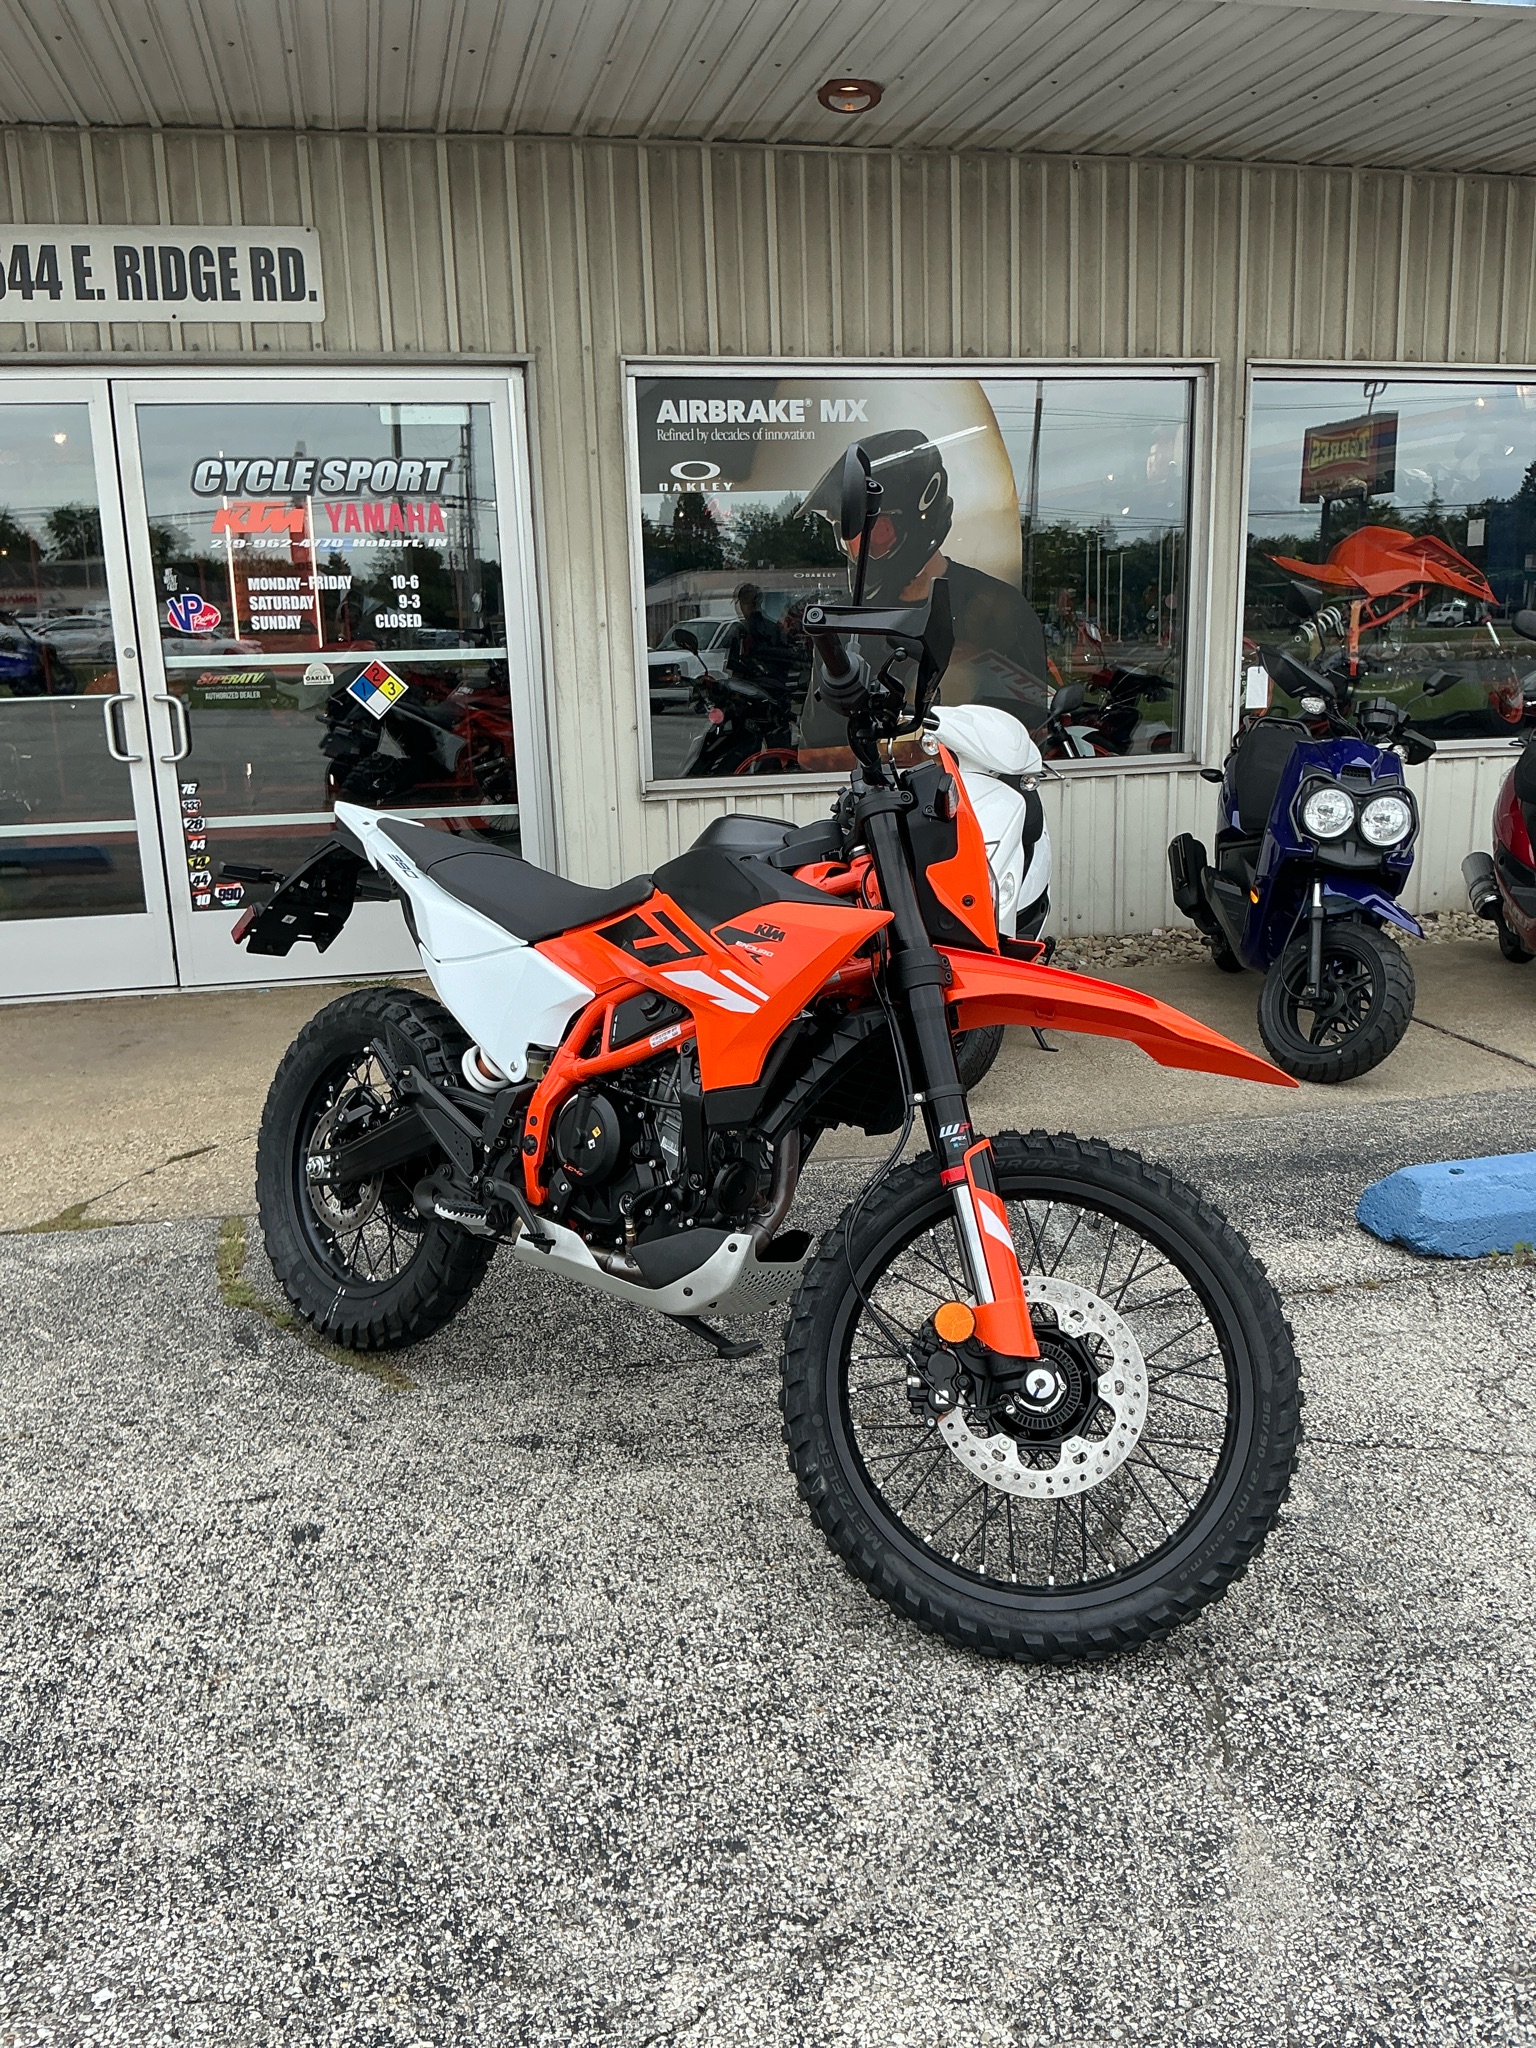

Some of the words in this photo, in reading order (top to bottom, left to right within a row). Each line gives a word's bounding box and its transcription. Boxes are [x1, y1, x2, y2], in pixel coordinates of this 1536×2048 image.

[0, 244, 62, 300] 44
[71, 245, 106, 301] E.
[113, 245, 241, 302] RIDGE
[249, 246, 318, 302] RD.
[820, 399, 869, 423] MX
[656, 428, 694, 441] Refined
[696, 428, 708, 444] by
[710, 428, 750, 441] decades
[752, 428, 764, 441] of
[764, 428, 816, 440] innovation
[192, 457, 316, 495] CYCLE
[318, 457, 450, 495] SPORT
[659, 482, 733, 492] OAKLEY
[211, 501, 305, 533] KTM
[324, 502, 446, 533] YAMAHA
[352, 538, 424, 549] Hobart,
[427, 538, 449, 548] IN
[391, 574, 420, 590] 10-6
[249, 595, 315, 611] SATURDAY
[398, 594, 421, 609] 9-3
[167, 593, 203, 632] VP
[251, 615, 302, 630] SUNDAY
[375, 613, 423, 629] CLOSED
[371, 667, 381, 683] 2
[205, 691, 239, 700] AUTHORIZED
[239, 690, 261, 699] DEALER
[361, 683, 368, 697] 1
[387, 682, 396, 696] 3
[183, 801, 200, 811] 333
[186, 818, 204, 831] 28
[189, 839, 207, 851] 44
[192, 873, 208, 886] 44
[195, 894, 212, 906] 10
[217, 887, 242, 901] 990
[753, 922, 787, 942] KTM
[735, 940, 775, 957] ENDURO
[939, 1122, 970, 1139] WP
[817, 1436, 883, 1551] METZELER
